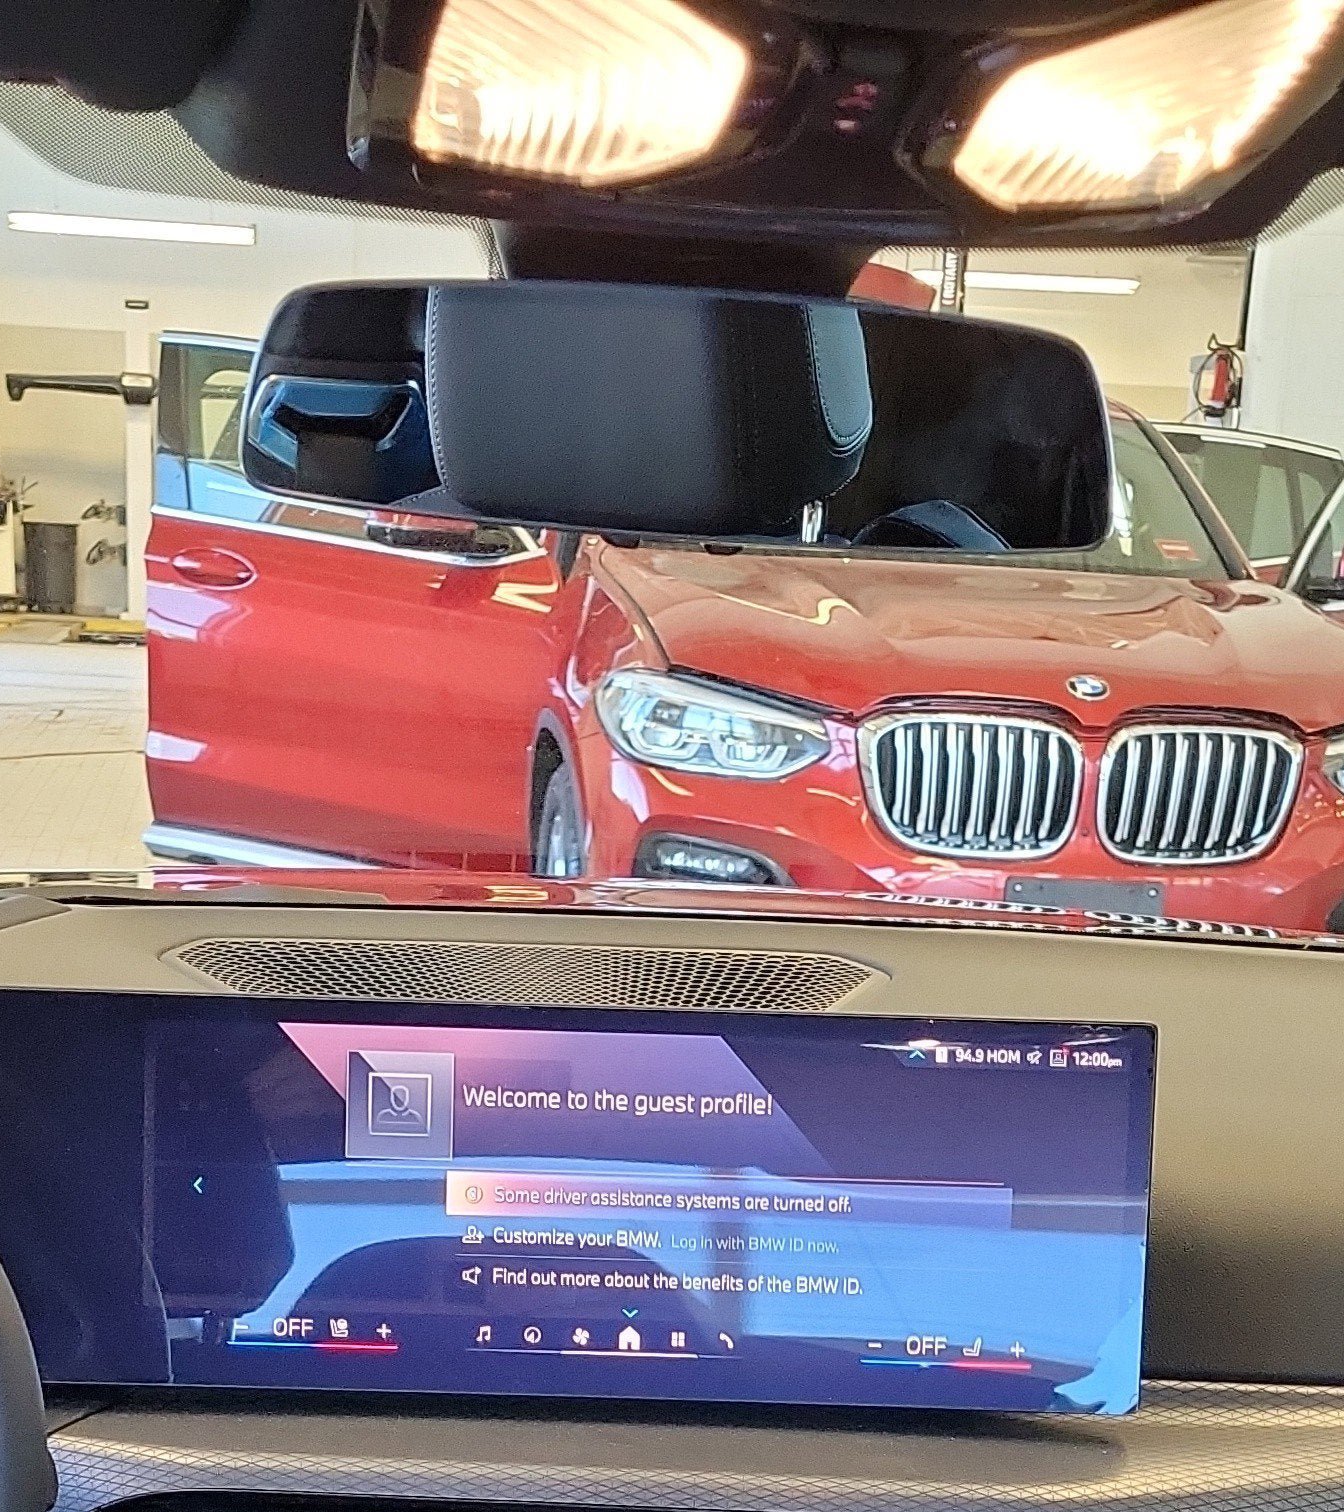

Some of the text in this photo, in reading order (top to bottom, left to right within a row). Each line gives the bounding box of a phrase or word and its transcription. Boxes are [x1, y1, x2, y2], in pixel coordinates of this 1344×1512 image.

[955, 1048, 984, 1063] 94.9
[987, 1049, 1021, 1064] HOM
[462, 1084, 773, 1117] Welcome to the guest profile!
[494, 1186, 852, 1213] Some driver assistance systems are turned off.
[493, 1226, 662, 1249] Customize your BMW.
[671, 1234, 839, 1254] Log in with BMW ID now.
[492, 1267, 863, 1295] Find out more about the benefits of the BMW ID.
[272, 1317, 314, 1337] OFF
[906, 1335, 948, 1356] OFF
